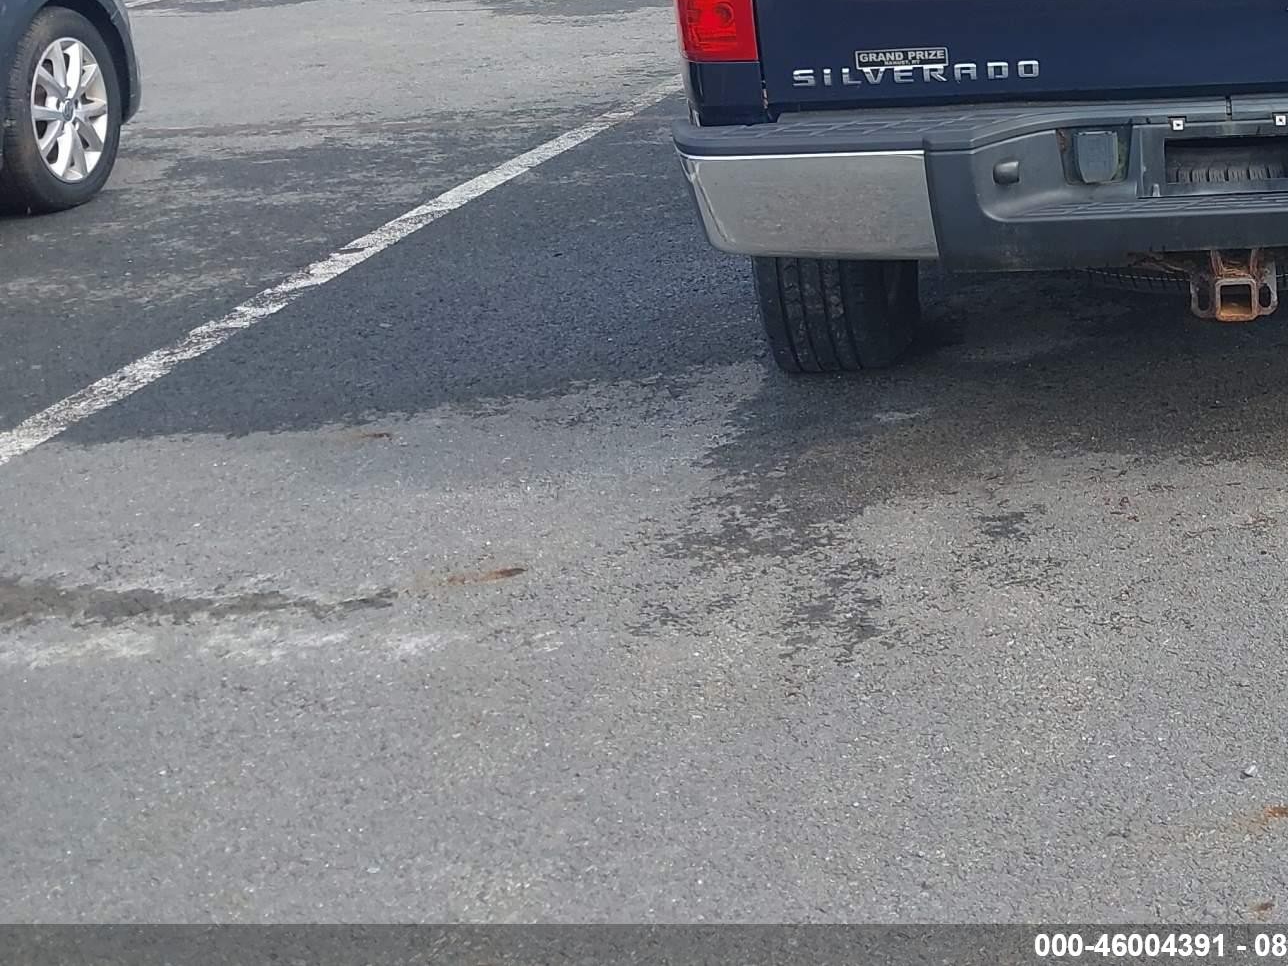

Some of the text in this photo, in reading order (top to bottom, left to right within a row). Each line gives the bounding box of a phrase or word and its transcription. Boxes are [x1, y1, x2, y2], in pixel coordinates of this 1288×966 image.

[859, 50, 945, 62] GRAND PRIZE
[792, 60, 1040, 87] SILVERADO
